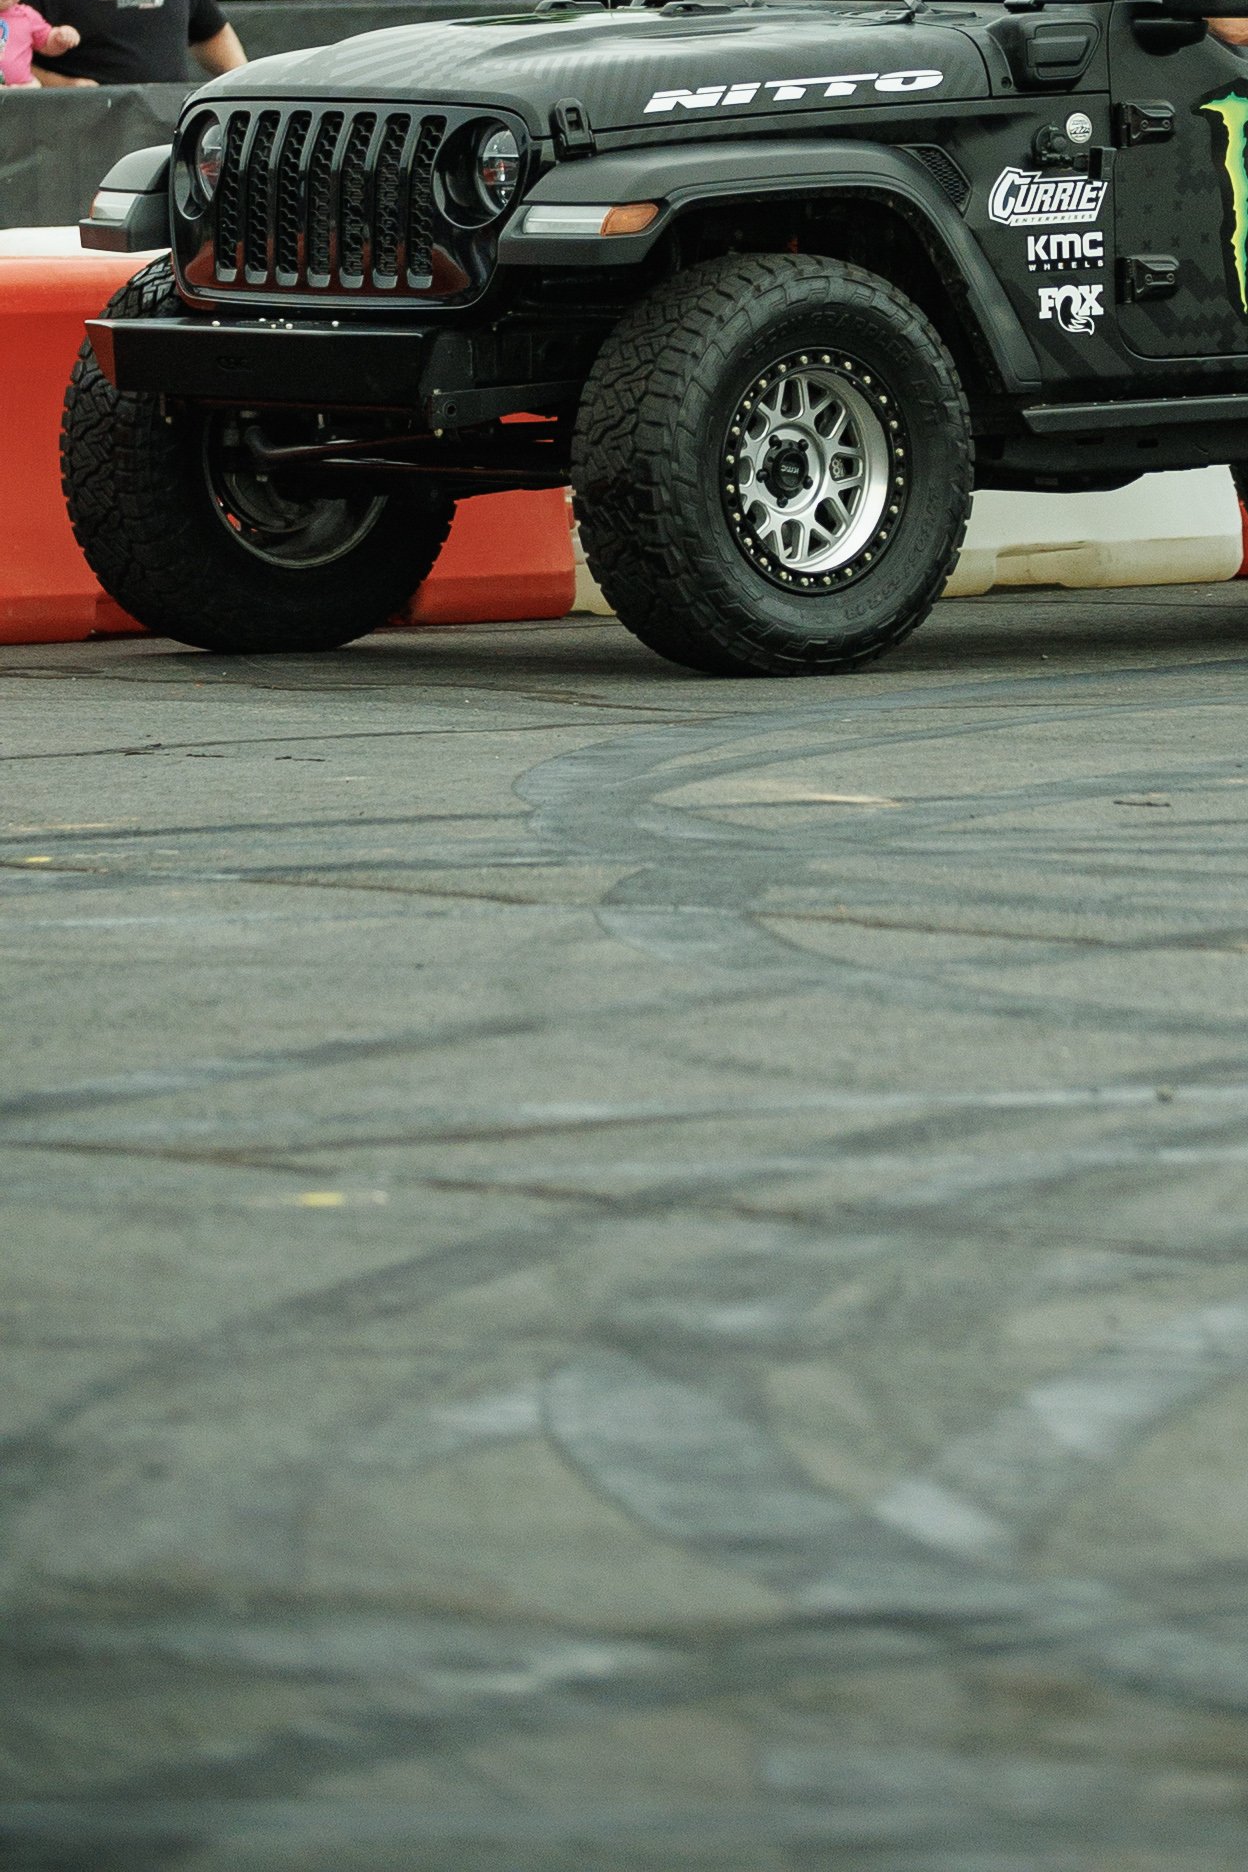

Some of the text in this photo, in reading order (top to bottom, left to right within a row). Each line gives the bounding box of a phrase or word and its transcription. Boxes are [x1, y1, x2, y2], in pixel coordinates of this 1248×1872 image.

[643, 69, 943, 113] NITTO
[993, 173, 1103, 219] CURRIE
[1014, 214, 1094, 224] ENTERPRISES
[1027, 231, 1104, 261] KMC
[1028, 261, 1104, 272] WHEELS
[1038, 284, 1104, 335] FOX
